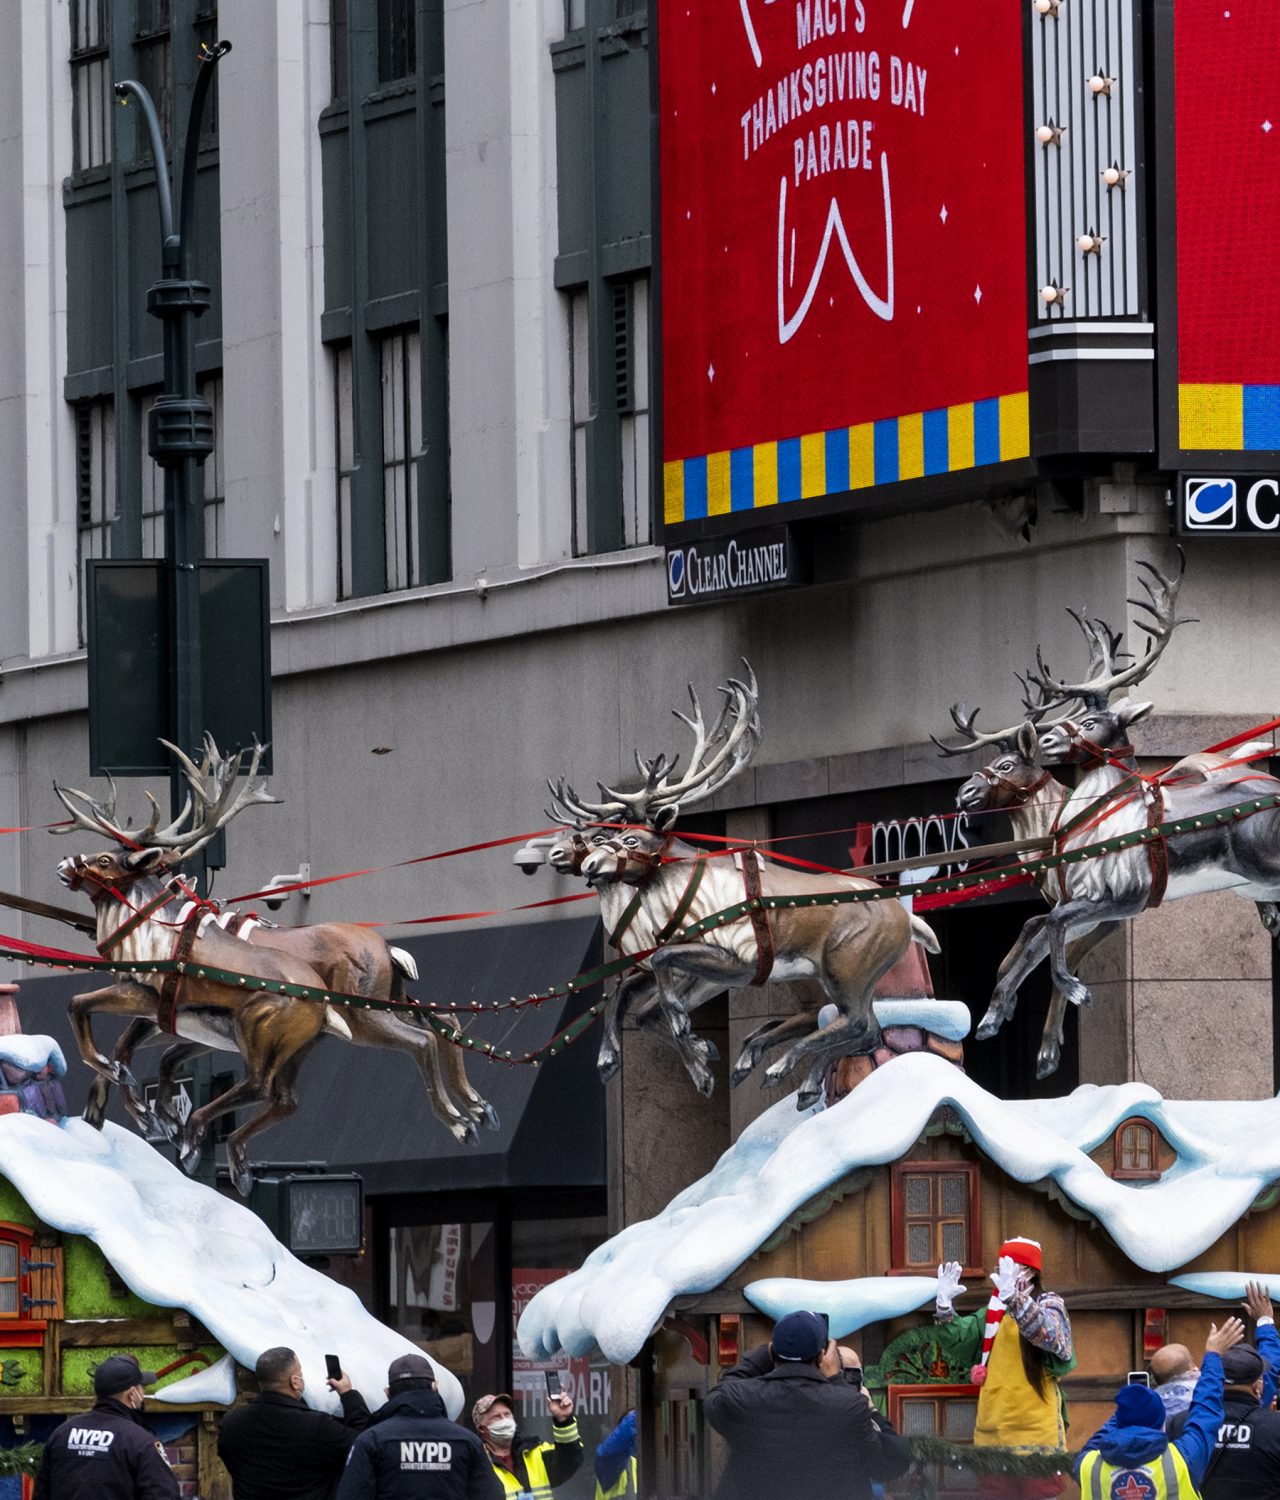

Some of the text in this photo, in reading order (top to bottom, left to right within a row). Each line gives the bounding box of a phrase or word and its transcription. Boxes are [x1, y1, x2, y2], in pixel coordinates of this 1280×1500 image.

[796, 0, 866, 50] MACYS
[741, 50, 928, 161] THANKSGIVING DAY
[793, 119, 874, 188] PARADE
[68, 1427, 114, 1447] NYPD
[1218, 1424, 1251, 1442] YPD
[401, 1441, 452, 1463] NYPD
